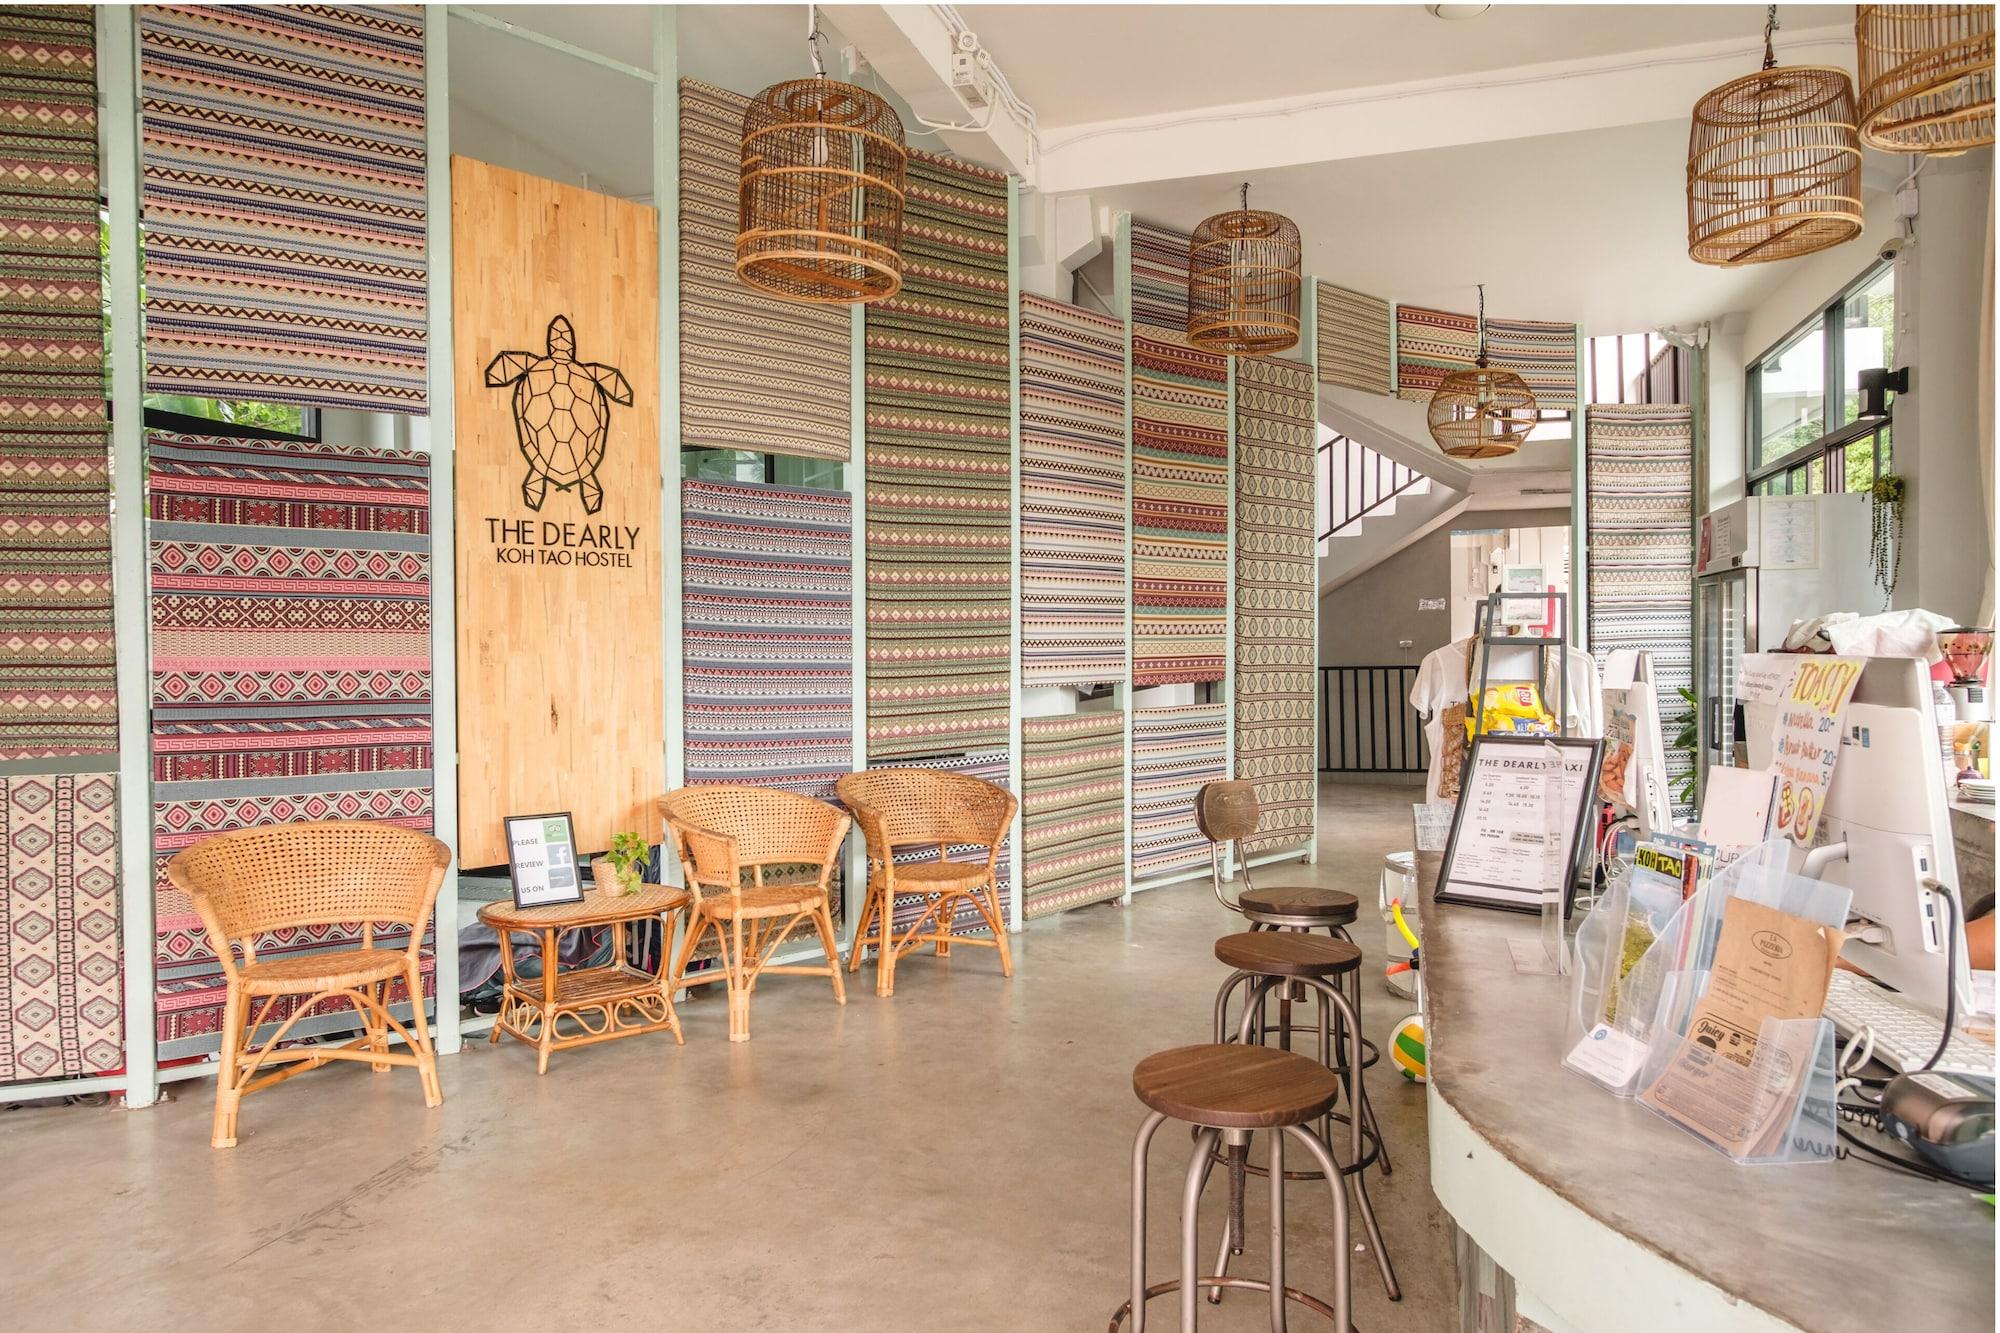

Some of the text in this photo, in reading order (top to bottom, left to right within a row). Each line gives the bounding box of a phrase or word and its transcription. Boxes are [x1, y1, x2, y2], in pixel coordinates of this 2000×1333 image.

[485, 518, 640, 550] THE DEARLY
[497, 547, 632, 568] KOH TAO HOSTEL
[1792, 662, 1858, 713] TOASTY
[1479, 759, 1498, 767] THE
[513, 838, 539, 846] PLEASE
[515, 860, 544, 869] REVIEW
[1638, 849, 1681, 877] KOH TAO
[521, 886, 531, 894] US
[1697, 1020, 1726, 1042] Juicy
